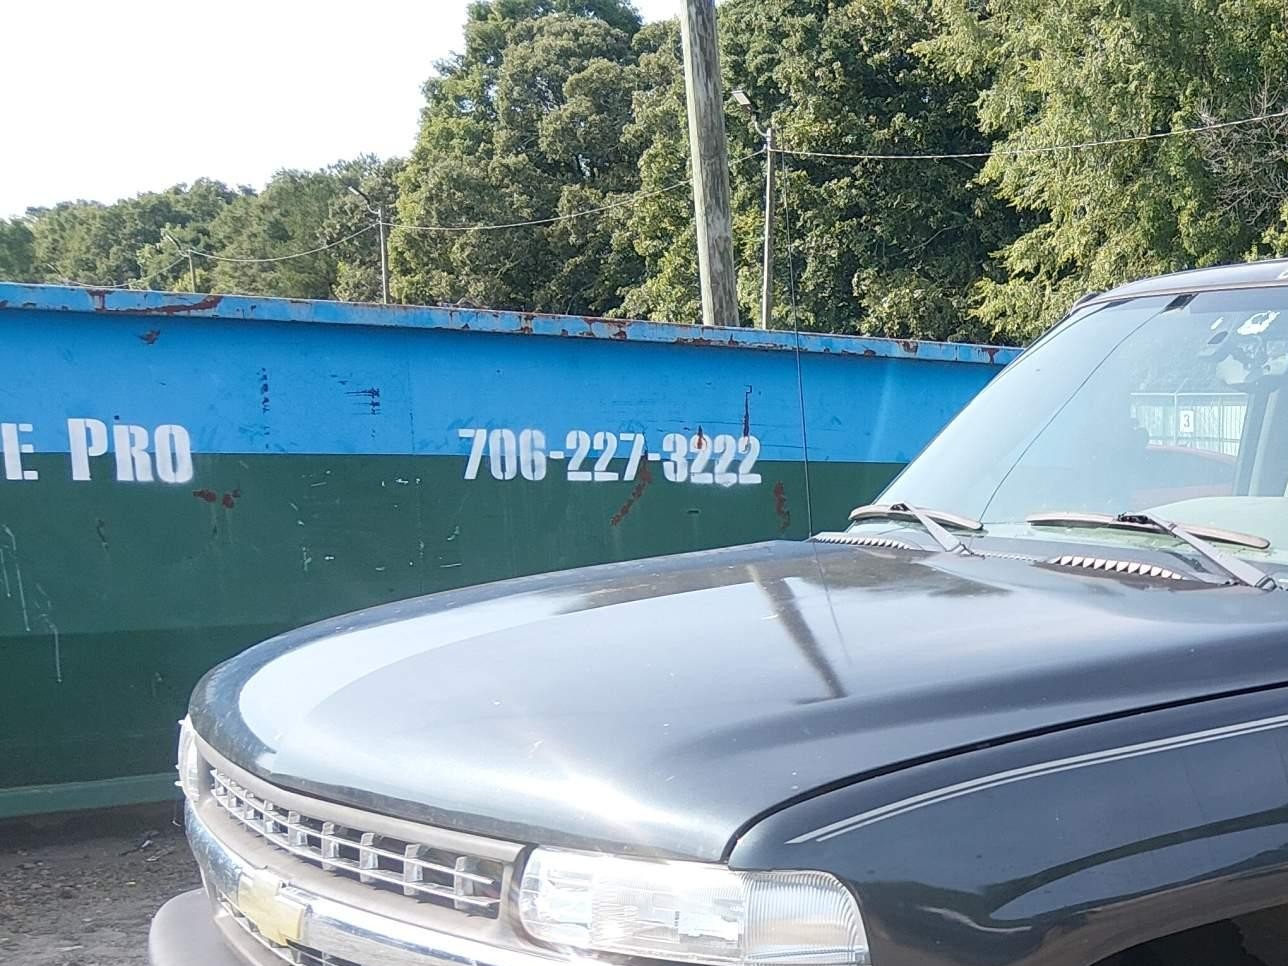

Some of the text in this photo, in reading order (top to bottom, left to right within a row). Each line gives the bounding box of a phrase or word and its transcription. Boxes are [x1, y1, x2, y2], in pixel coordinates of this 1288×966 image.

[1, 417, 195, 483] E PRO
[1182, 414, 1191, 428] 3
[458, 428, 762, 487] 706-227-3222
